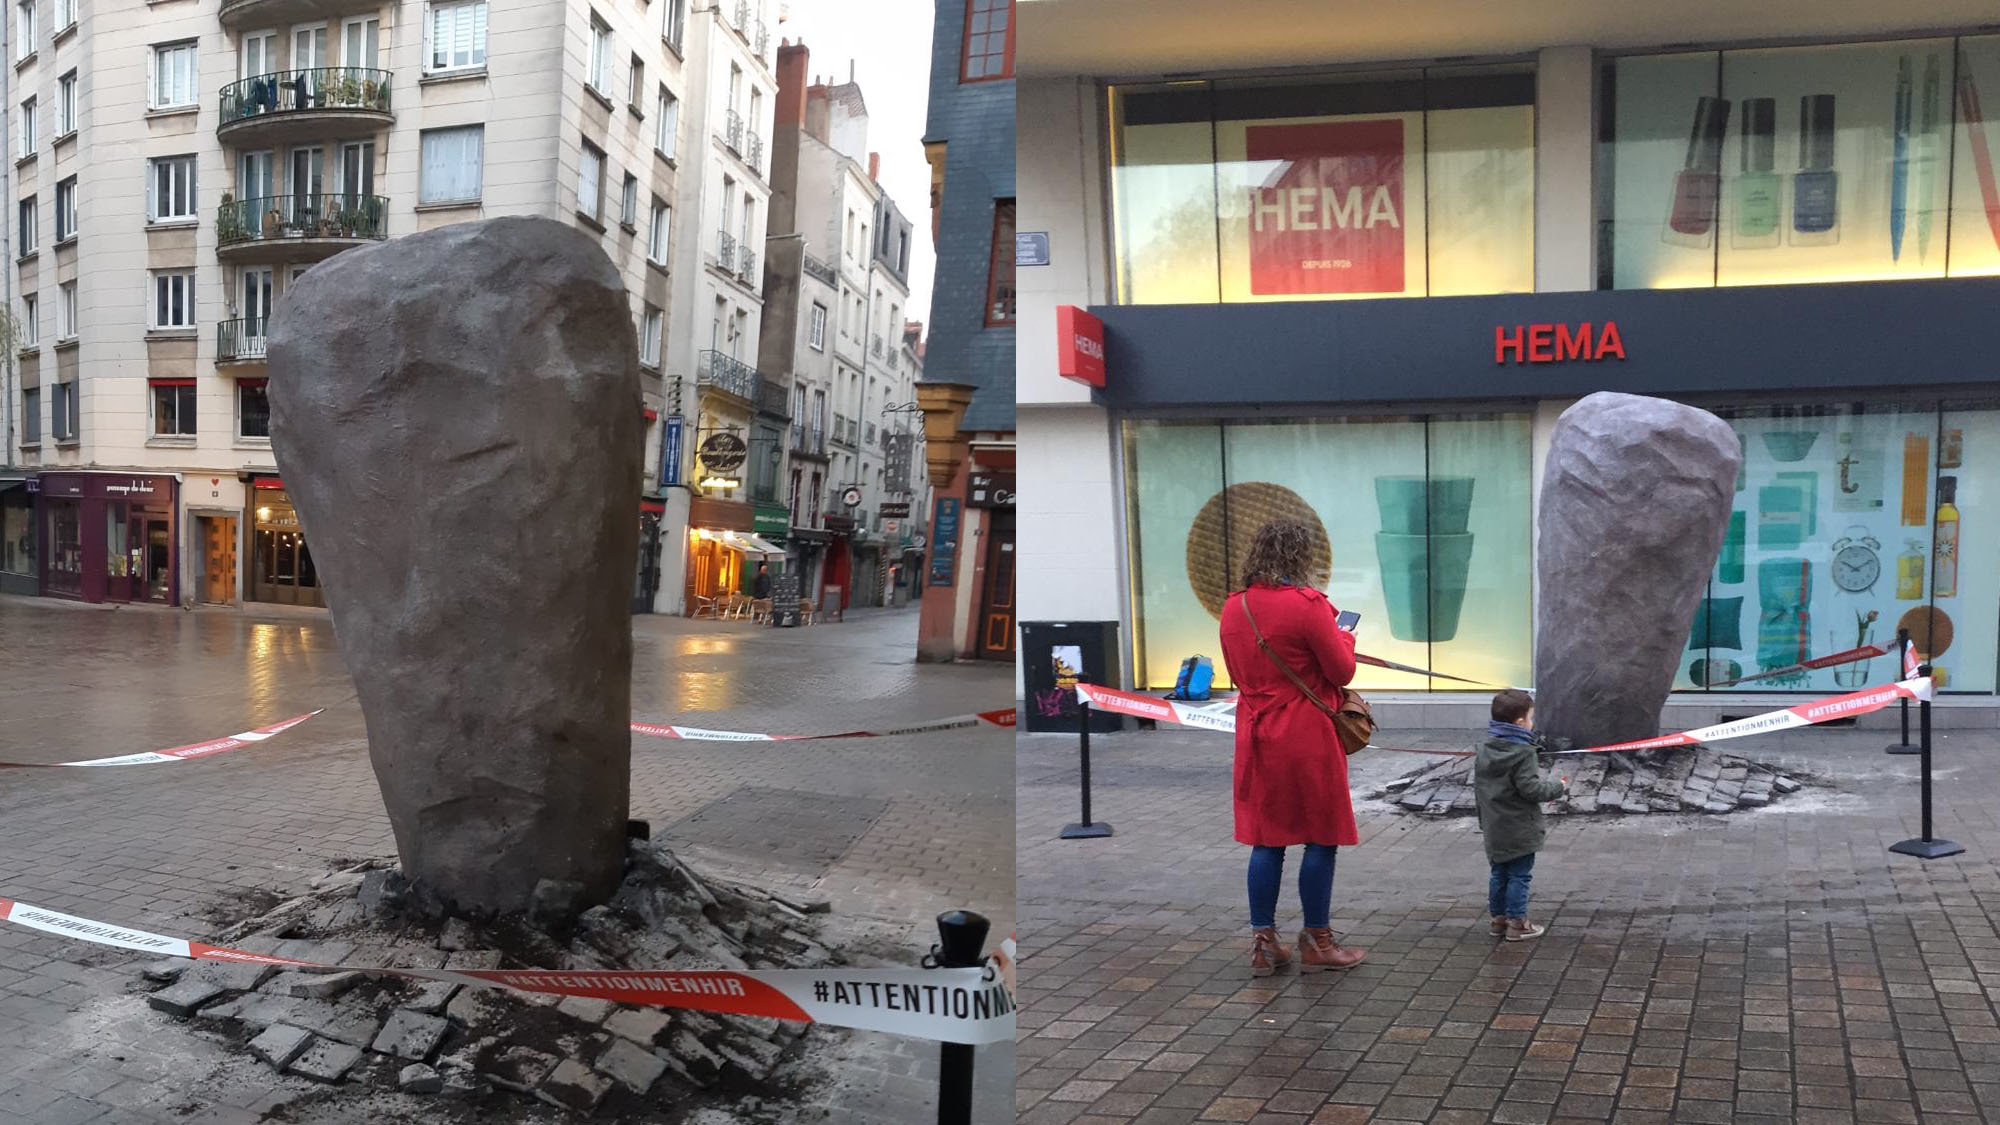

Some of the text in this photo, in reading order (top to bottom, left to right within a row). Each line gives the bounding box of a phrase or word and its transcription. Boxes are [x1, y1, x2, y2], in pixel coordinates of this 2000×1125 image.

[1254, 185, 1401, 232] HEMA
[1302, 260, 1331, 269] DEPUIS
[1074, 334, 1104, 361] HEMA
[1496, 321, 1625, 363] HEMA
[1807, 690, 1898, 718] #ATTENTIONMENHIR
[1704, 715, 1791, 738] #ATTENTIONMENHIR
[504, 974, 747, 996] #ATTENTIONMENHIR
[814, 980, 1016, 1020] #ATTENTIONM
